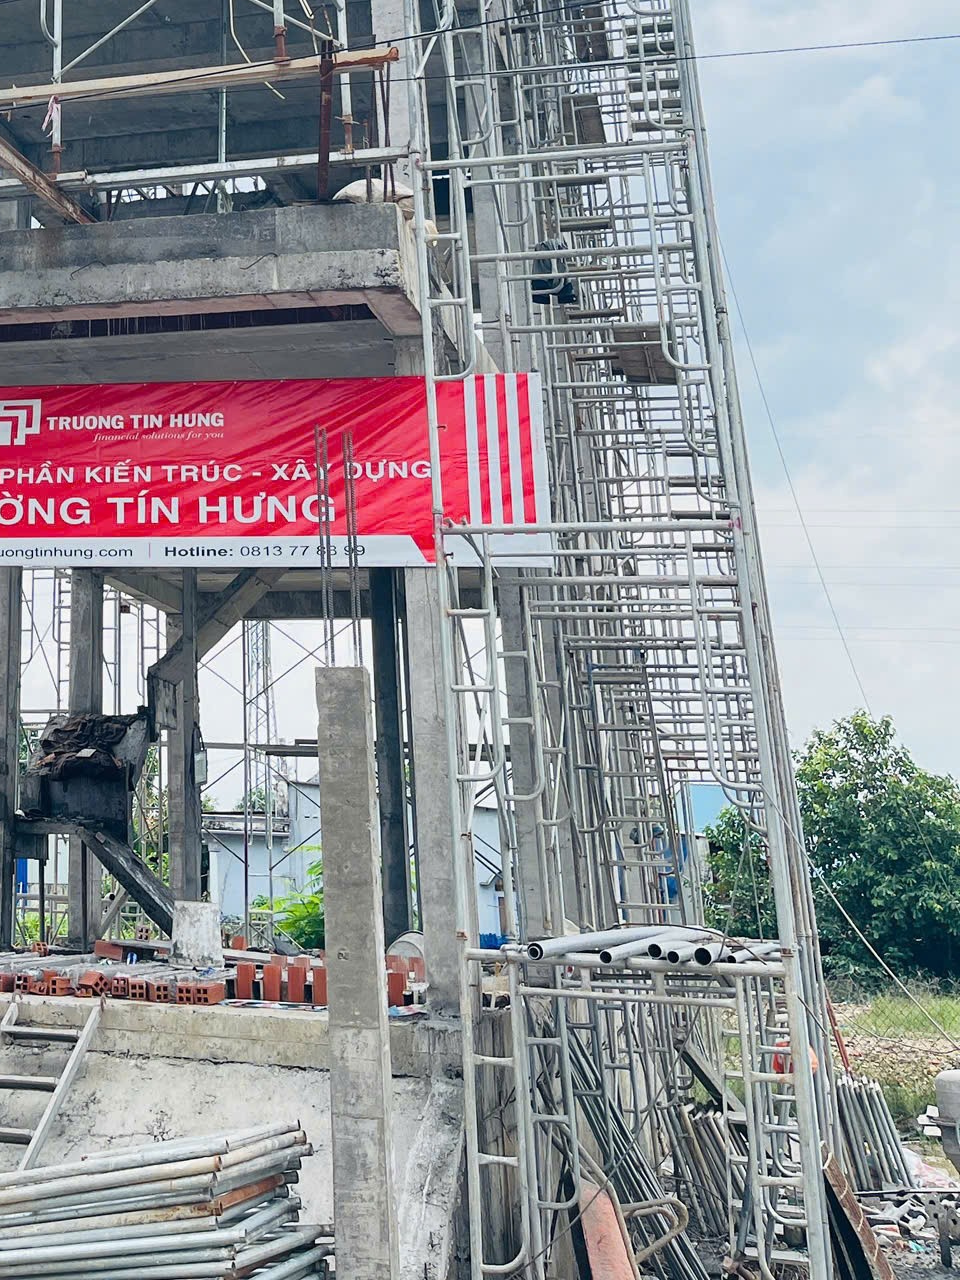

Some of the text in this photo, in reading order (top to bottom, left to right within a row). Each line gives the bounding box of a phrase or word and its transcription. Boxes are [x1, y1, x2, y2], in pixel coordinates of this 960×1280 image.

[47, 412, 224, 431] TRUONG TIN HUNG
[93, 431, 224, 443] financial solutions for you
[0, 460, 74, 484] PHẦN
[85, 458, 152, 483] KIẾN
[161, 460, 242, 483] TRÚC
[107, 489, 179, 525] TÍN
[198, 491, 336, 524] HƯNG
[164, 546, 233, 557] Hotline:
[240, 546, 283, 557] 0813
[289, 546, 309, 556] 77
